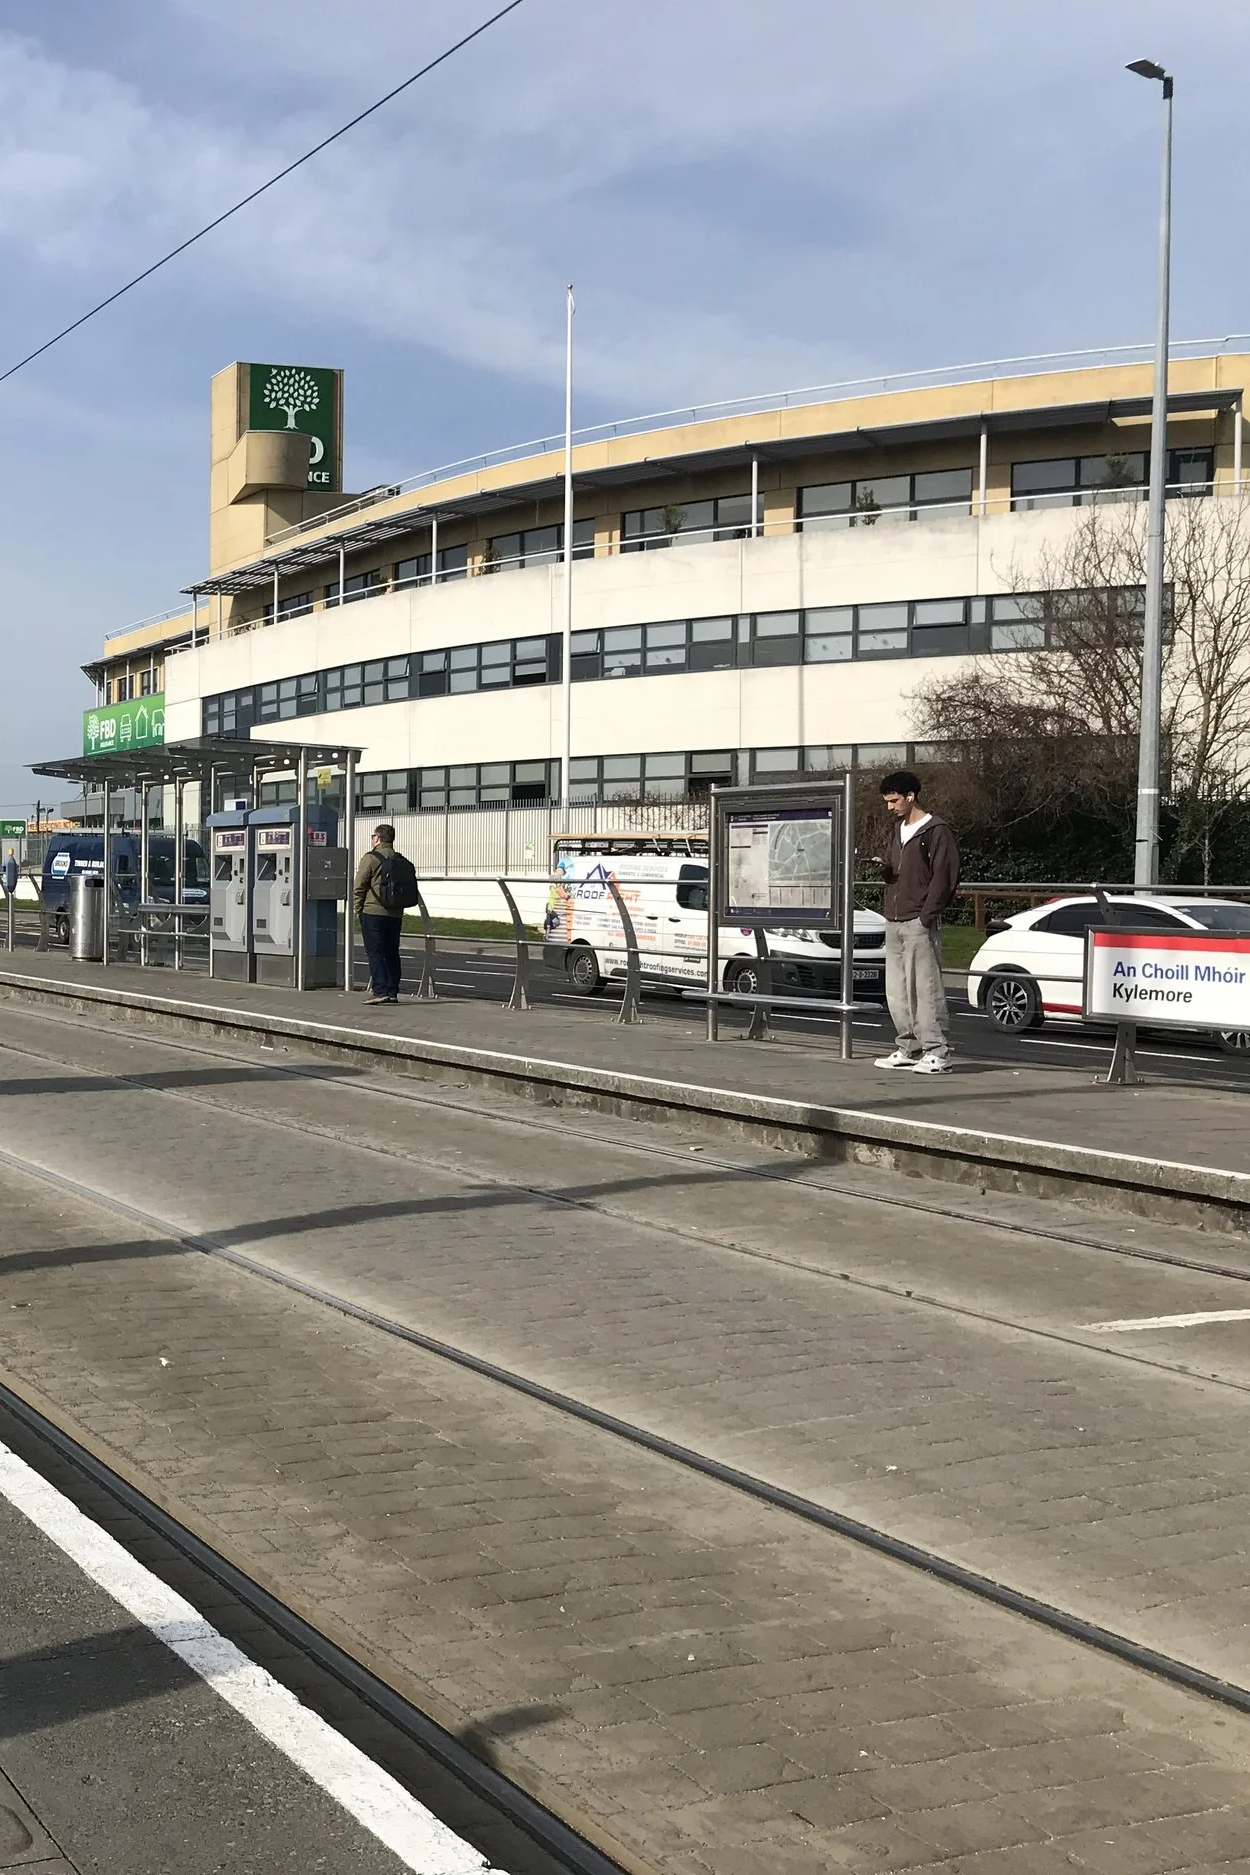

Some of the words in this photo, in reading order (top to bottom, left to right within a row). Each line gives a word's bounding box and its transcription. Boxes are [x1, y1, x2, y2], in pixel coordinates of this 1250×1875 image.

[100, 718, 117, 740] FBD
[576, 890, 605, 899] ROOF
[1112, 961, 1137, 978] An
[1141, 963, 1189, 981] Choill
[1194, 965, 1246, 984] Mhóir
[1112, 983, 1193, 1003] Kylemore
